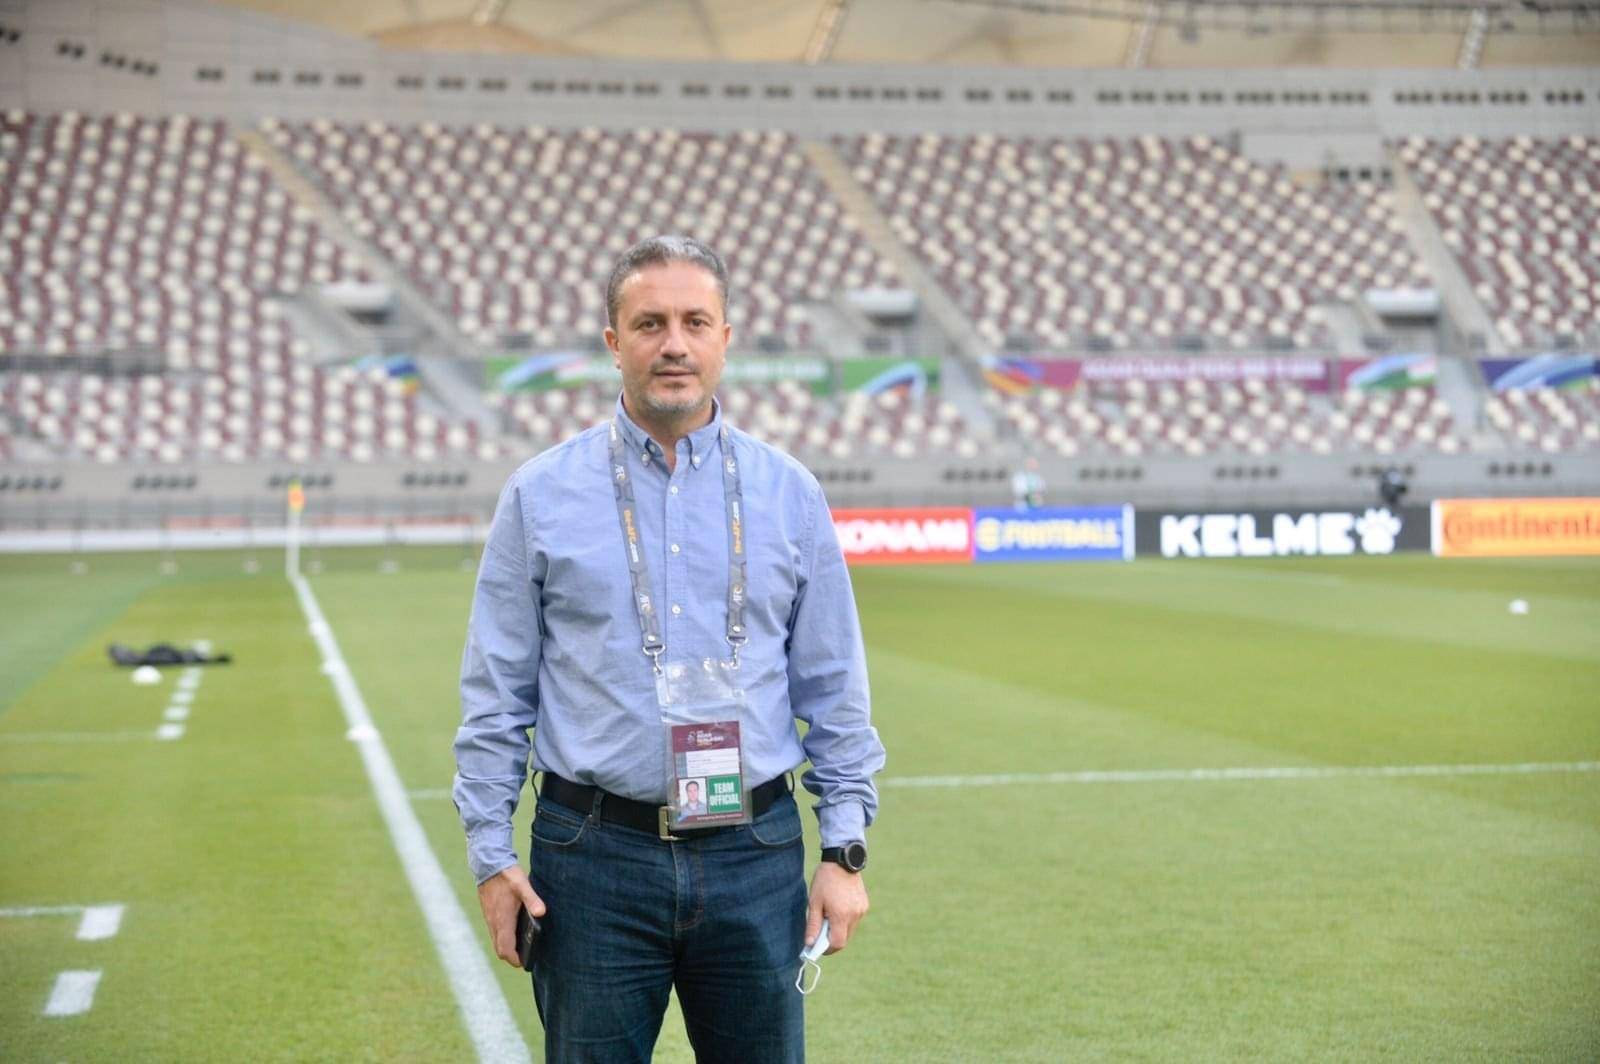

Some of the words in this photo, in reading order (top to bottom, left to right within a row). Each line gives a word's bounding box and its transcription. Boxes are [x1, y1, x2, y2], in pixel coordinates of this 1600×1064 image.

[615, 464, 626, 481] AFC
[1161, 513, 1356, 558] KELME
[640, 593, 651, 613] AFC
[714, 782, 735, 795] TEAM
[709, 793, 740, 806] OFFICIAL
